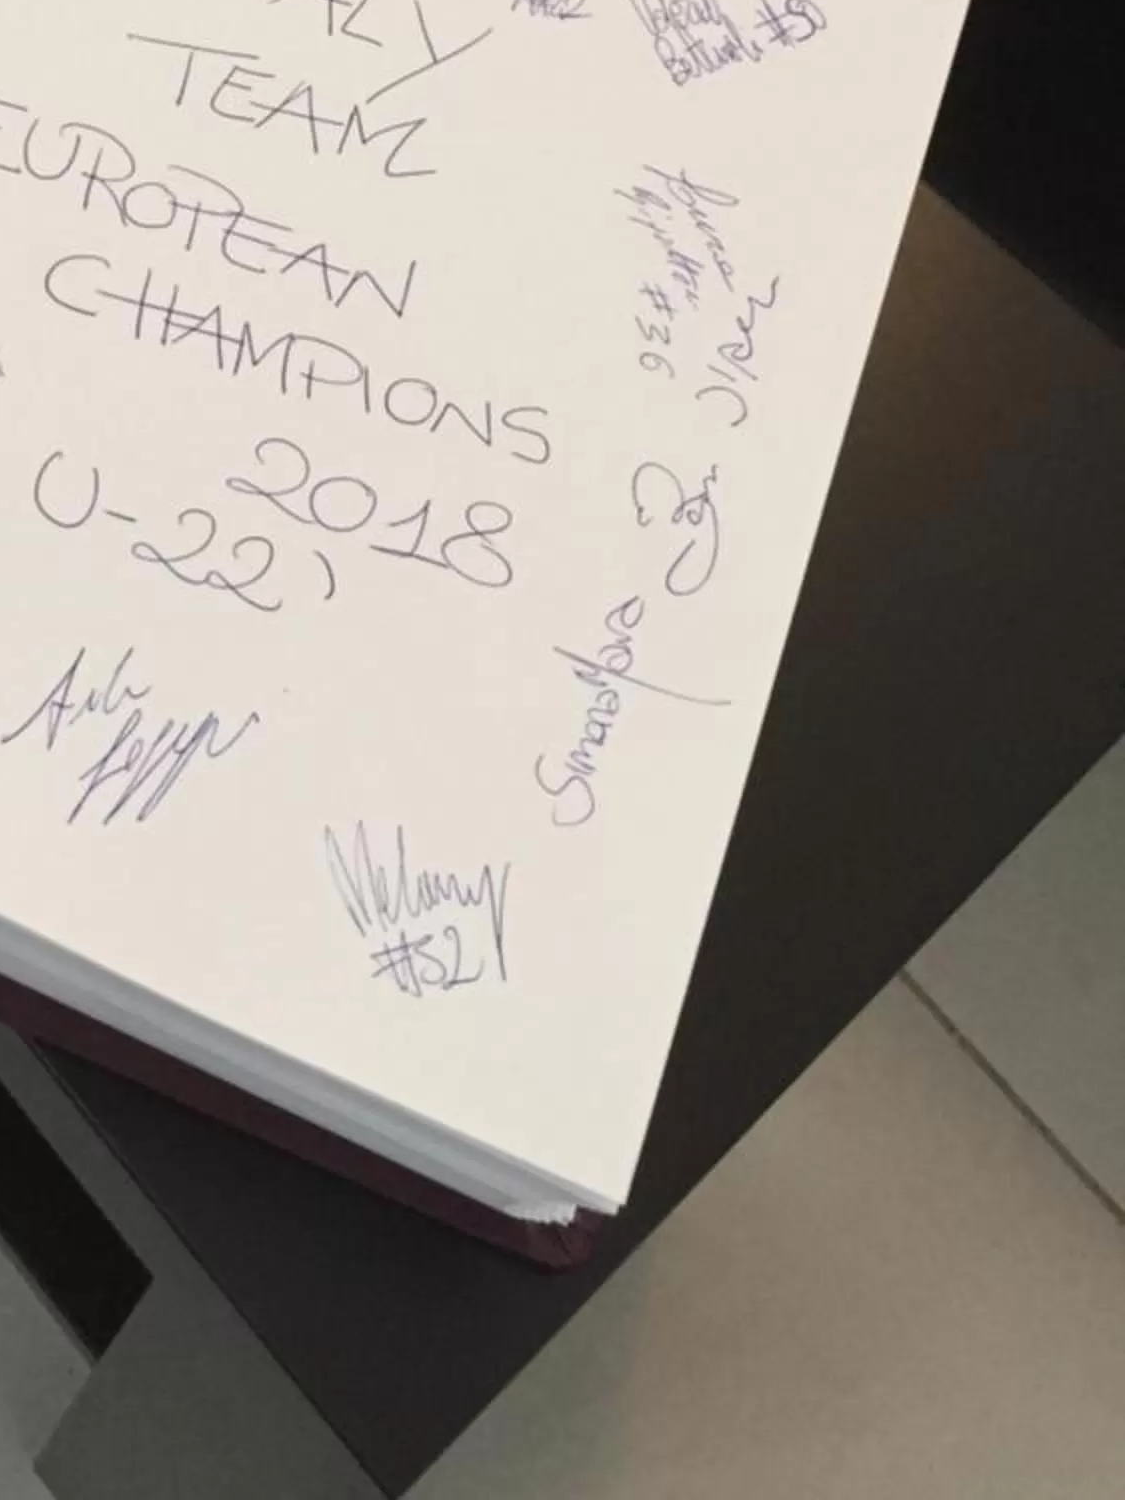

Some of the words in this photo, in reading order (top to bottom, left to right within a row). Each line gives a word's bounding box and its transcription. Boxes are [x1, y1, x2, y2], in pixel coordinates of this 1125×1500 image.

[126, 32, 438, 178] TEAM
[43, 253, 551, 466] CHAMPIONS
[225, 437, 515, 588] 2018
